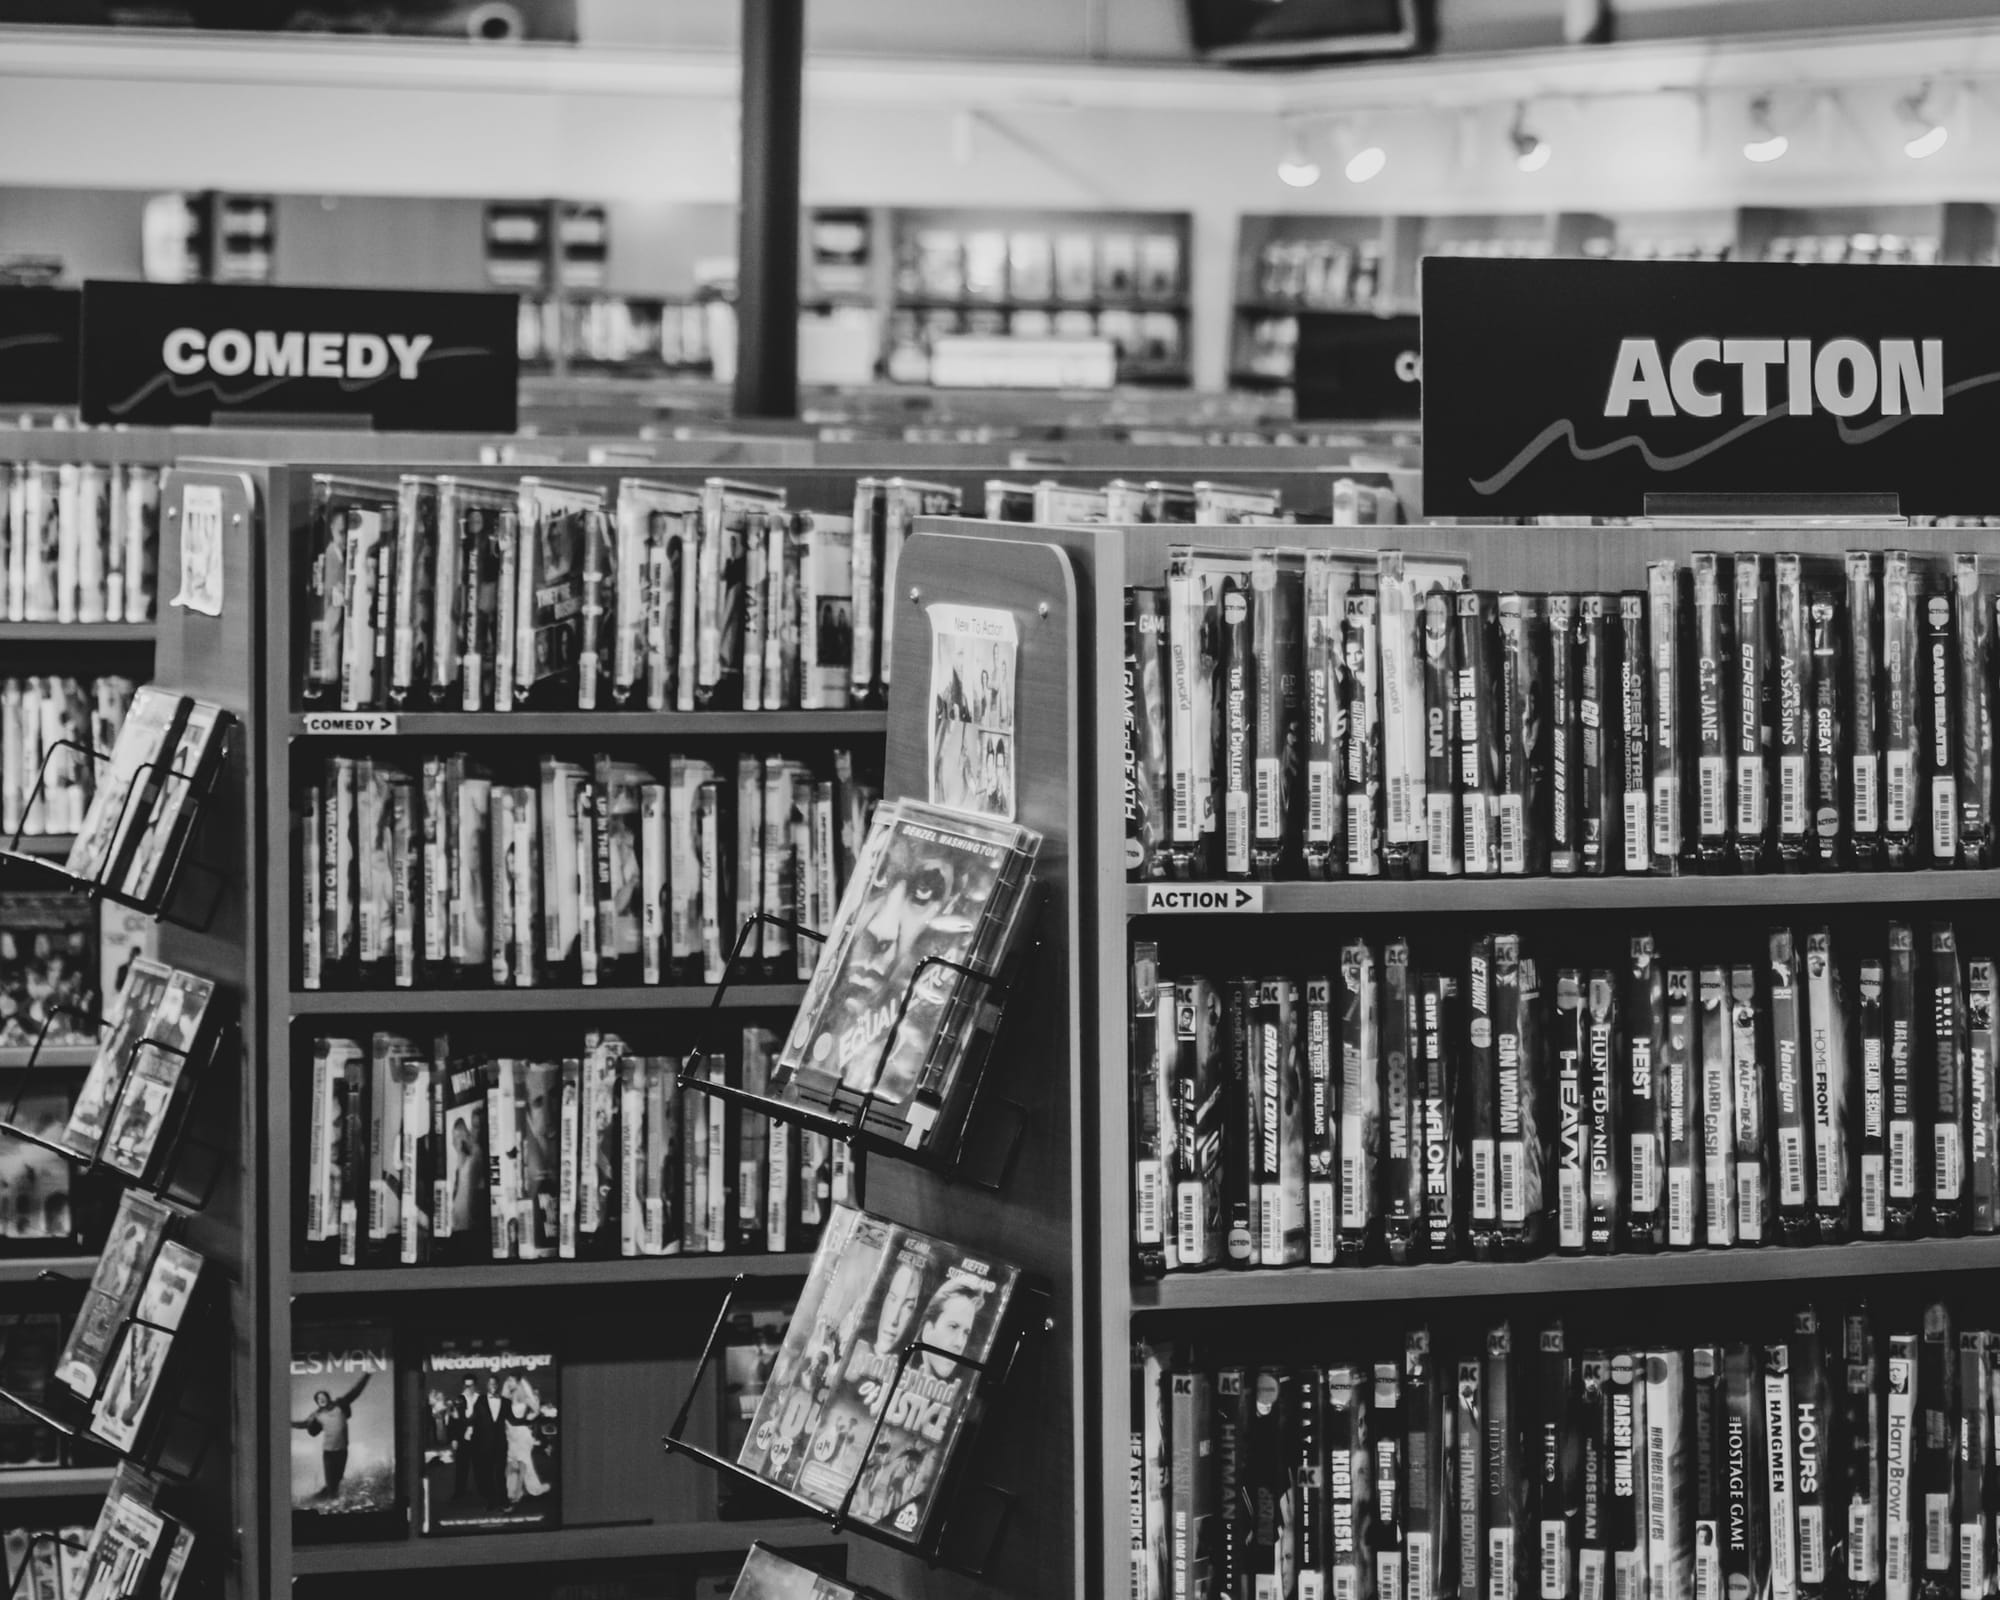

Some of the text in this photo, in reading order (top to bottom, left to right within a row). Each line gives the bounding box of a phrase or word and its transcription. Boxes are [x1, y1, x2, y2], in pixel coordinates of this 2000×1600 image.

[162, 328, 432, 380] COMEDY
[1604, 339, 1944, 416] ACTION
[954, 617, 970, 632] New
[972, 618, 981, 634] To
[1347, 601, 1364, 615] AC
[1582, 600, 1598, 615] AC
[1230, 666, 1244, 728] THE GREAT
[1503, 662, 1511, 752] GUARANTEED ON
[1622, 662, 1630, 732] HOOLIGANS
[1631, 674, 1642, 739] GREEN
[1659, 642, 1670, 748] THE GAUNTLET
[1699, 658, 1717, 741] G.I. JANE
[1742, 643, 1754, 752] GORGEOUS
[1781, 656, 1795, 745] ASSASSINS
[1856, 635, 1868, 716] GUNS FOR
[1891, 640, 1903, 739] GODS EGYPT
[1933, 643, 1947, 767] GANG RELATED
[312, 719, 374, 730] COMEDY
[1348, 700, 1365, 783] GUTSHOT STRAIGHT
[1429, 707, 1443, 757] GUN
[1459, 667, 1478, 788] THE GOOD THIEF
[1554, 728, 1565, 762] GONE
[1818, 678, 1831, 801] THE GREAT FIGHT
[1124, 749, 1136, 820] DEATH
[1554, 763, 1565, 773] IN
[596, 797, 608, 882] UP IN THE AIR
[902, 824, 1000, 858] DENZEL WASHINGTON
[1554, 790, 1565, 843] SECONDS
[1818, 818, 1838, 826] ACTION
[326, 799, 336, 910] WELCOME TO ME
[1152, 892, 1228, 908] ACTION
[1176, 989, 1192, 1003] AC
[1262, 988, 1278, 1001] AC
[1309, 987, 1325, 1001] AC
[1471, 957, 1486, 1014] GETAWAY
[1671, 975, 1686, 989] AC
[1972, 967, 1987, 980] AC
[1234, 991, 1243, 1080] GLIMMER MAN
[1944, 987, 1953, 1036] BRUCE
[1264, 1023, 1277, 1174] GROUND CONTROL
[1313, 1011, 1324, 1135] GREEN STREET HOOLIGANS
[1424, 993, 1444, 1194] GIVE 'EM HELL MALONE
[1498, 1034, 1518, 1133] GUN WOMAN
[1591, 1026, 1607, 1113] HUNTED
[1632, 1038, 1650, 1099] HEIST
[1671, 1064, 1683, 1141] HUDSON HAWK
[1739, 1059, 1751, 1142] HALF DEAD
[1779, 1040, 1796, 1113] Handgun
[1814, 1029, 1829, 1127] HOMEFRONT
[1864, 1039, 1881, 1138] HOMELAND SECURITY
[1894, 1085, 1908, 1114] DEAD
[1937, 1041, 1954, 1114] HOSTAGE
[1560, 1051, 1578, 1171] HEAVY
[1595, 1115, 1605, 1133] BY
[1705, 1070, 1721, 1157] HARD CASH
[1971, 1048, 1985, 1162] HUNT TO KILL
[1184, 1125, 1194, 1174] JOE
[1593, 1134, 1607, 1202] NIGHT
[1429, 1199, 1444, 1212] AC
[961, 1258, 990, 1276] KIEFER
[290, 1350, 388, 1375] ES MAN
[431, 1354, 552, 1373] Wedding Ringer
[1461, 1367, 1476, 1381] AC
[1584, 1364, 1600, 1378] AC
[1962, 1336, 1977, 1350] AC
[1175, 1379, 1191, 1394] AC
[1221, 1424, 1236, 1520] HITMAN
[1488, 1420, 1500, 1496] HIDALGO
[1544, 1423, 1556, 1482] HERO
[1613, 1394, 1633, 1497] HARSH TIMES
[1696, 1384, 1711, 1516] HEADHUNTERS
[1769, 1400, 1784, 1493] HANGMEN
[1798, 1404, 1816, 1493] HOURS
[1887, 1414, 1905, 1464] Harry
[1299, 1469, 1315, 1484] AC
[1332, 1450, 1352, 1552] HIGH RISK
[1460, 1432, 1476, 1588] THE HITMAN'S BODYGUARD
[1585, 1451, 1596, 1540] HORSEMAN
[1650, 1426, 1665, 1540] HIGH HEELS LOW LIFES
[1728, 1422, 1744, 1551] HOSTAGE GAME
[1175, 1512, 1186, 1530] HALF
[1175, 1540, 1186, 1558] LOAF
[1175, 1560, 1186, 1569] OF
